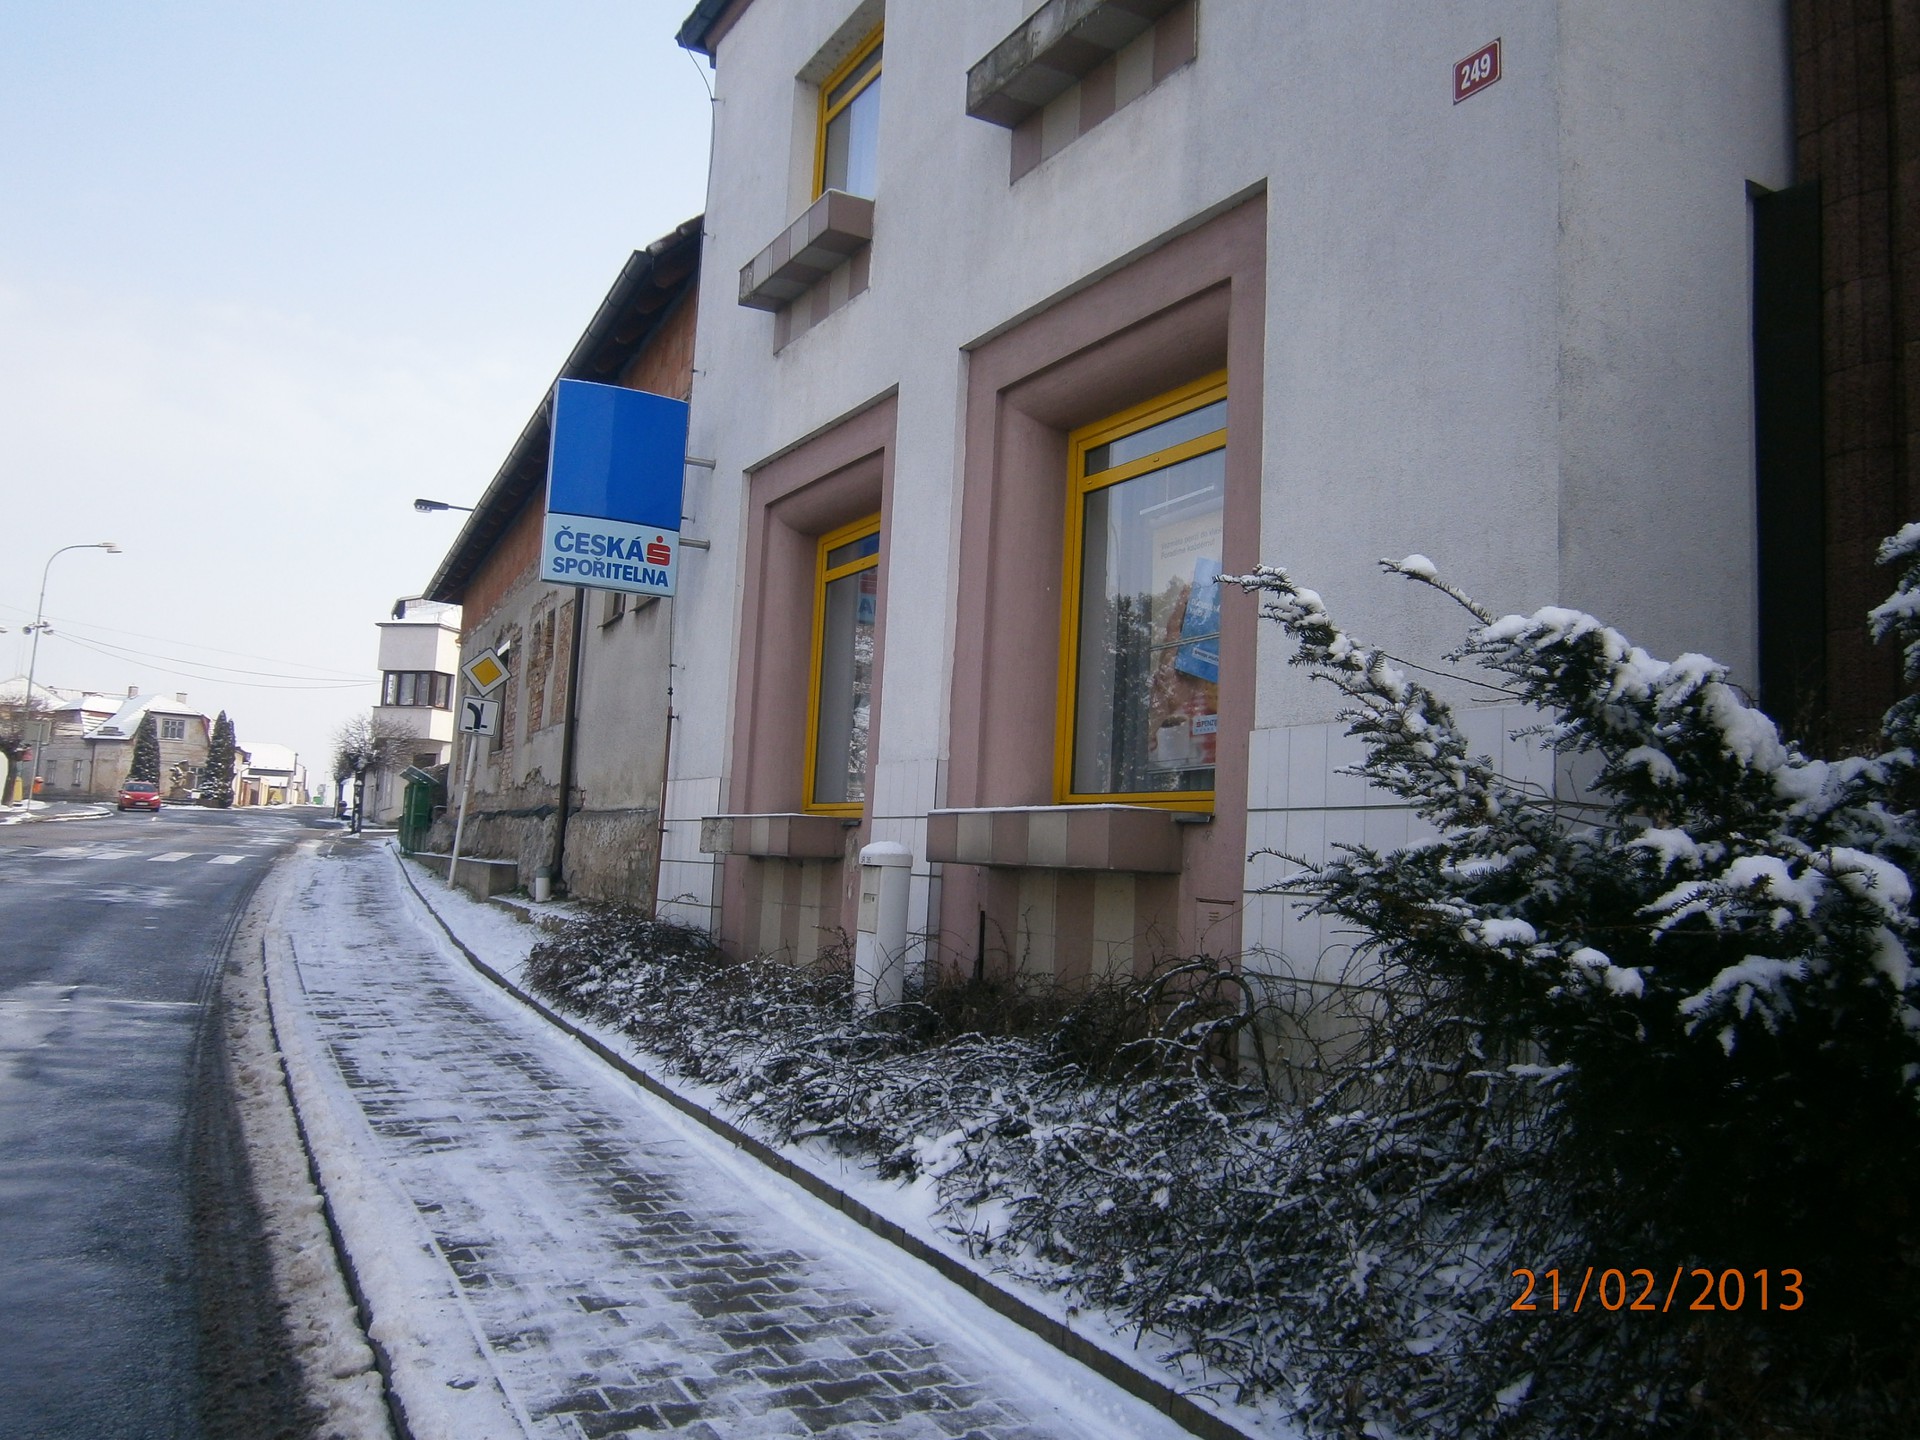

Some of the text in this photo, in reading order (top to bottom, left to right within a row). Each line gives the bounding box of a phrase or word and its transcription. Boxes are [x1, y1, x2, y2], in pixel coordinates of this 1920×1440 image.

[1461, 53, 1491, 90] 249
[554, 525, 645, 563] ČESKÁ
[552, 557, 669, 588] SPOŘITELNA
